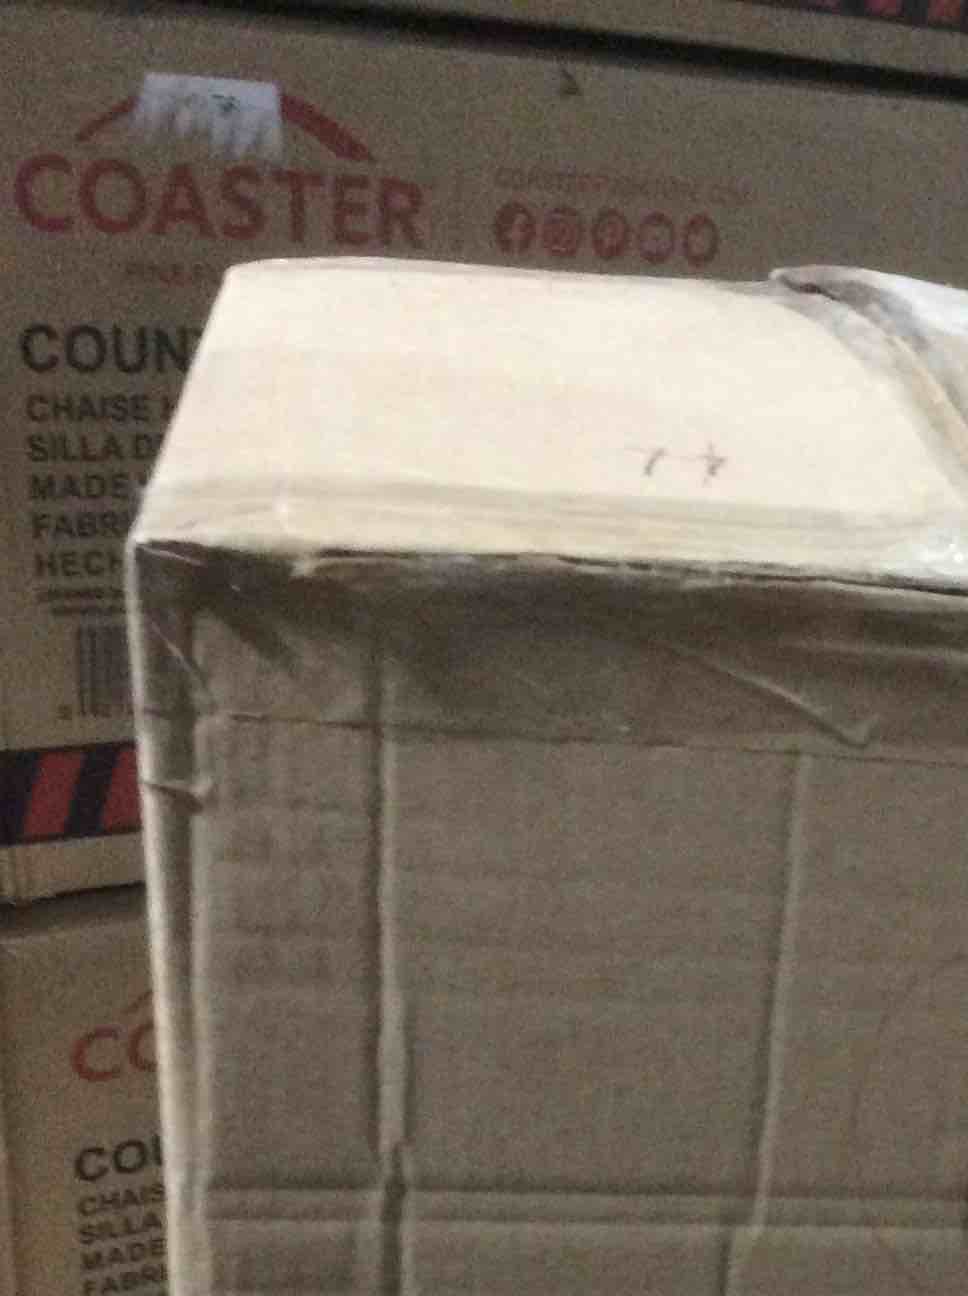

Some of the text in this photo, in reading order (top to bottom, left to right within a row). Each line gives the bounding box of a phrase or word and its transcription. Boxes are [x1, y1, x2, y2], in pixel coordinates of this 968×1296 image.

[15, 153, 423, 247] COASTER
[21, 323, 199, 374] COUN
[26, 394, 150, 422] CHAISE
[27, 433, 124, 462] SILLA
[29, 474, 129, 500] MADE
[79, 1211, 162, 1245] SILLA
